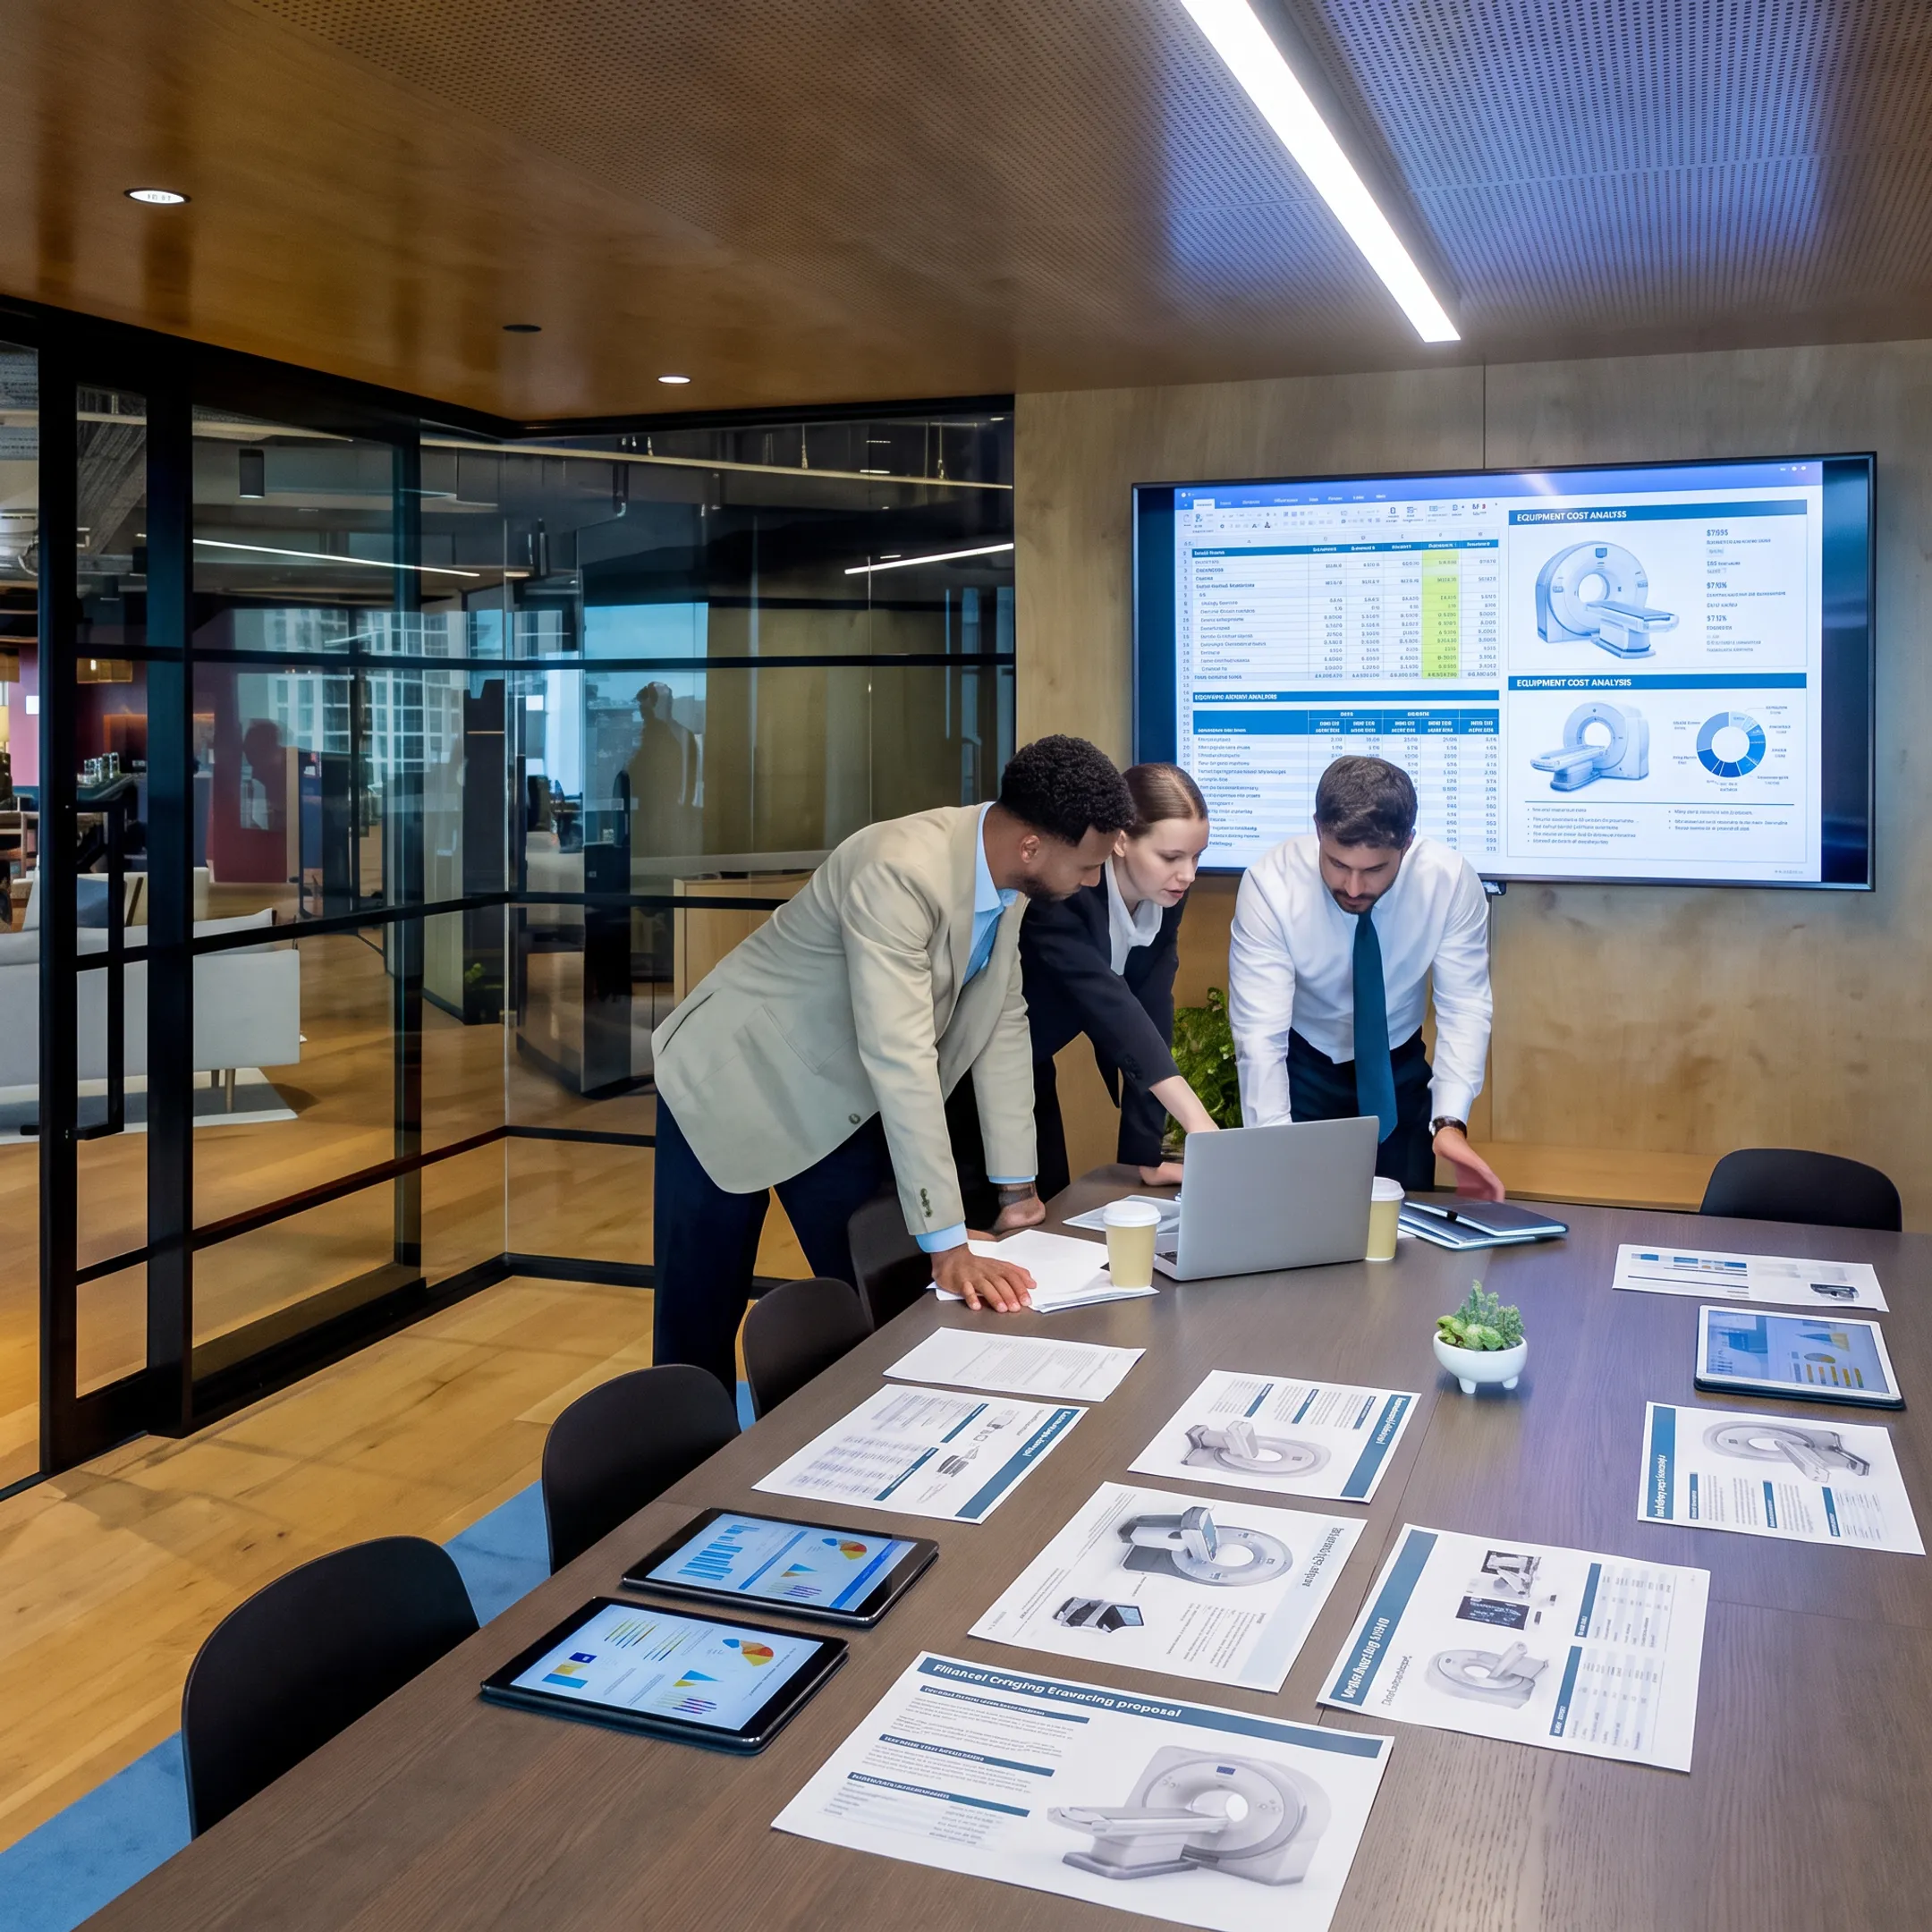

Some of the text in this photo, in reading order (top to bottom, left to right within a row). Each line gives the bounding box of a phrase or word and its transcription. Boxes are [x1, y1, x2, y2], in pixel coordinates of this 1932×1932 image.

[1516, 512, 1565, 522] EQUIPMENT
[1566, 511, 1589, 521] COST
[1516, 678, 1631, 688] EQUIPMENT COST ANALYSIS
[1115, 1700, 1182, 1718] proposal
